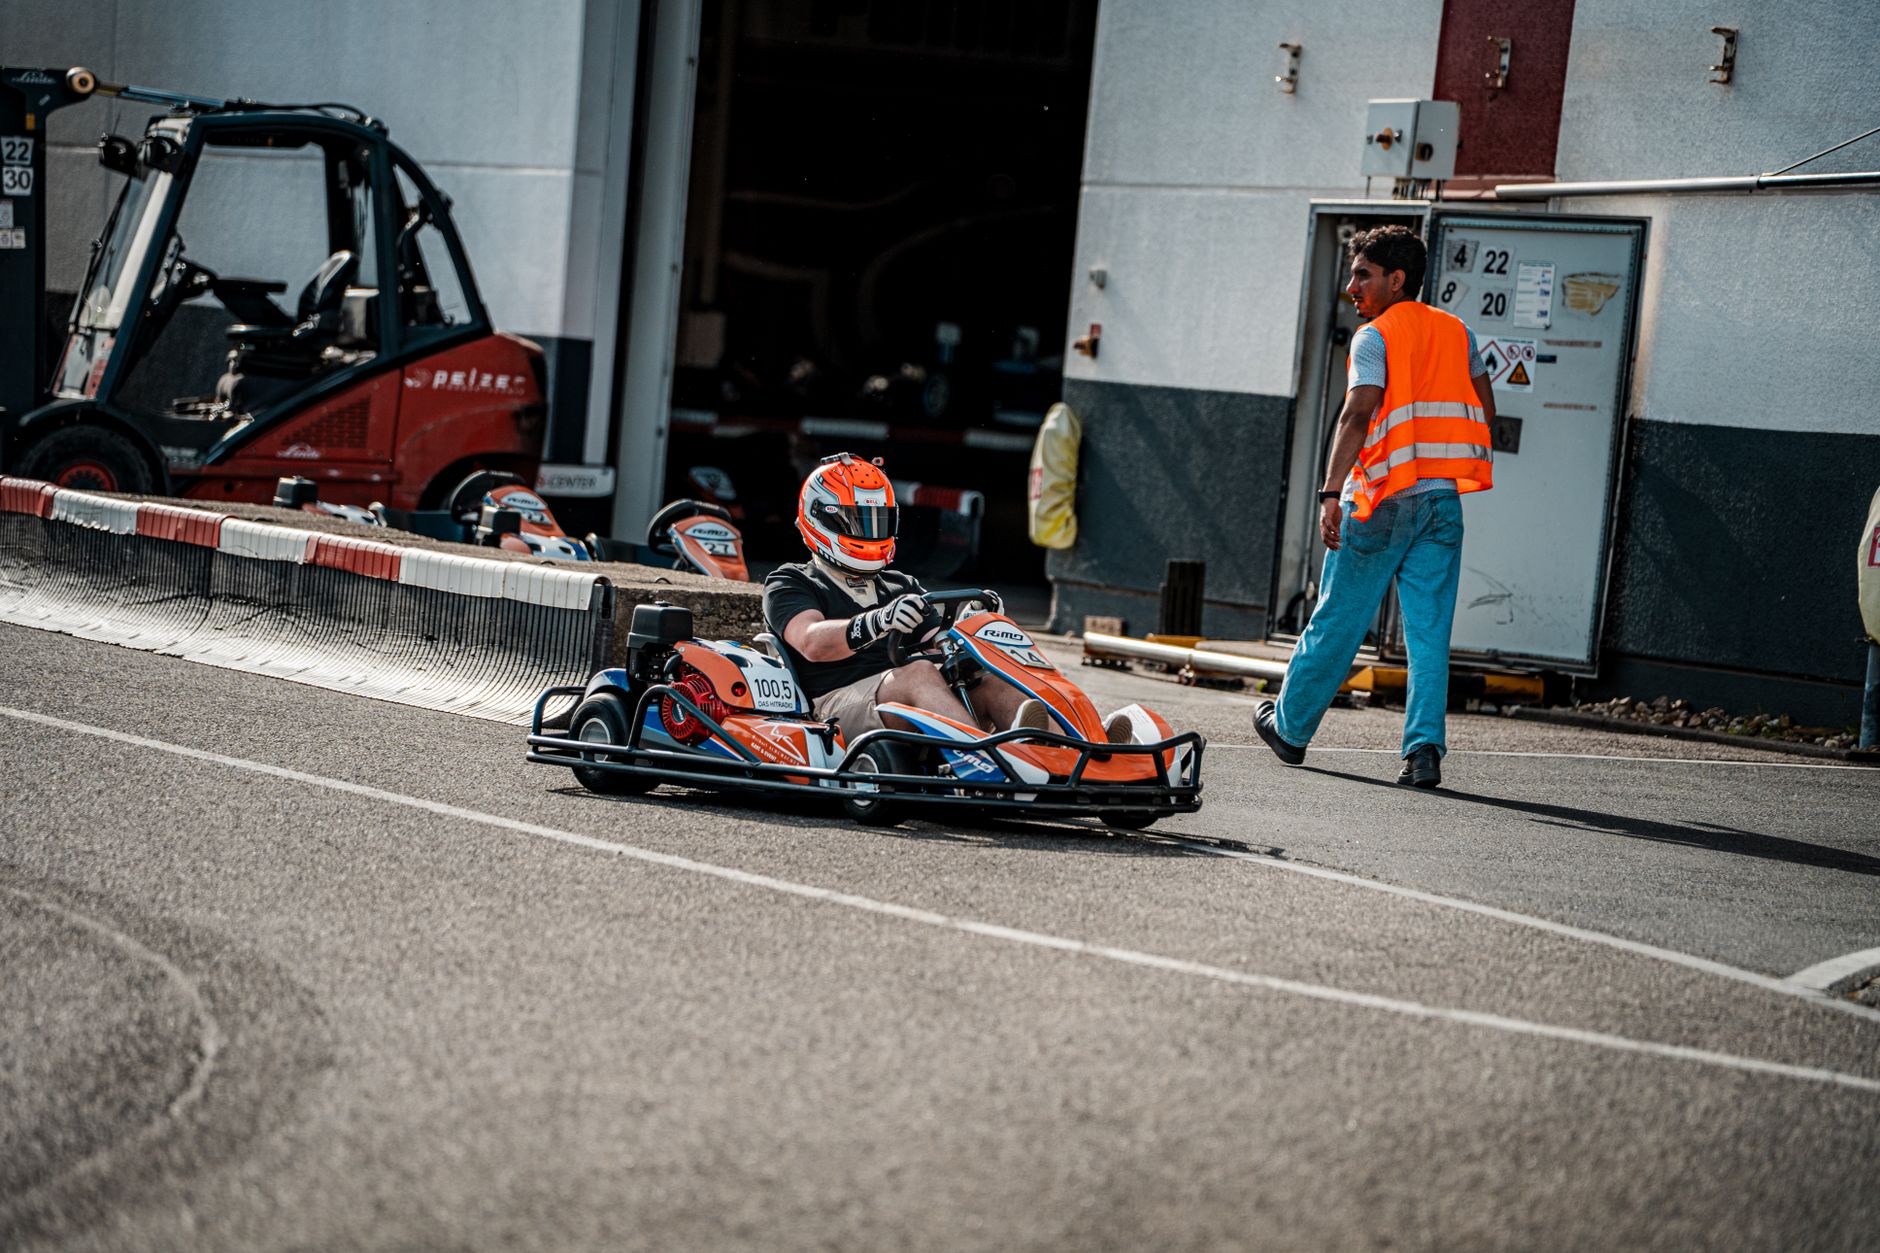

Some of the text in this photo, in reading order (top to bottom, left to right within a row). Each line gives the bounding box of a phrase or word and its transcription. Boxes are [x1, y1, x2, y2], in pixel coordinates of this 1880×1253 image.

[5, 141, 30, 162] 22
[4, 169, 31, 190] 30
[1454, 245, 1468, 268] 4
[1483, 250, 1510, 275] 22
[1441, 281, 1457, 303] 8
[1481, 292, 1507, 316] 20
[1010, 649, 1046, 665] 14
[758, 700, 770, 708] DAS
